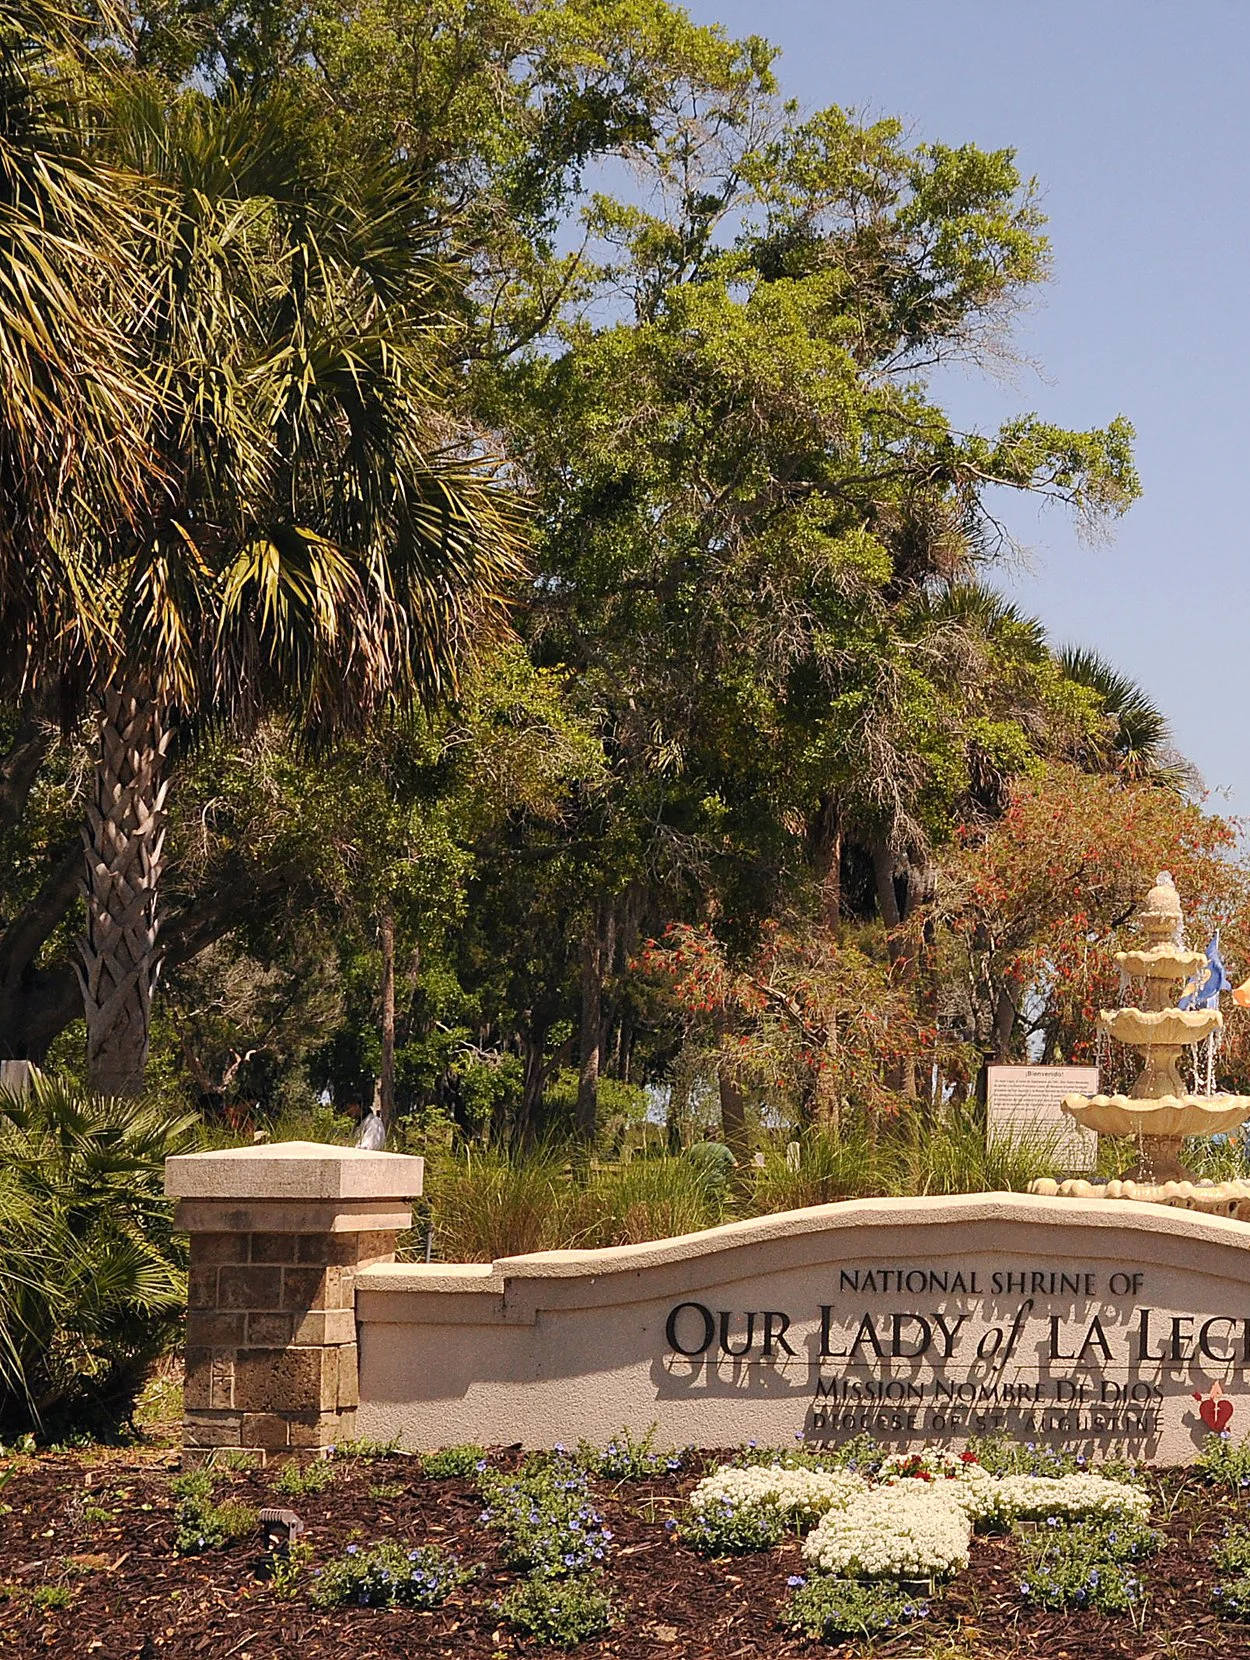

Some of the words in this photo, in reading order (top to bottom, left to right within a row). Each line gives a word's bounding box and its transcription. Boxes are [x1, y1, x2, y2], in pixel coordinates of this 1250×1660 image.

[839, 1269, 983, 1294] NATIONAL
[991, 1271, 1096, 1296] SHRINE
[1108, 1272, 1144, 1296] OF
[665, 1301, 799, 1357] OUR
[817, 1304, 970, 1359] LADY
[977, 1297, 1034, 1371] of
[1047, 1314, 1117, 1361] LA
[815, 1377, 924, 1403] MISSION
[935, 1379, 1045, 1404] NOMBRE
[1056, 1380, 1090, 1404] DE
[1100, 1380, 1164, 1404] DIOS
[814, 1412, 917, 1431] DIOCESE
[933, 1413, 961, 1432] OF
[1025, 1416, 1164, 1434] AUGUSTINE
